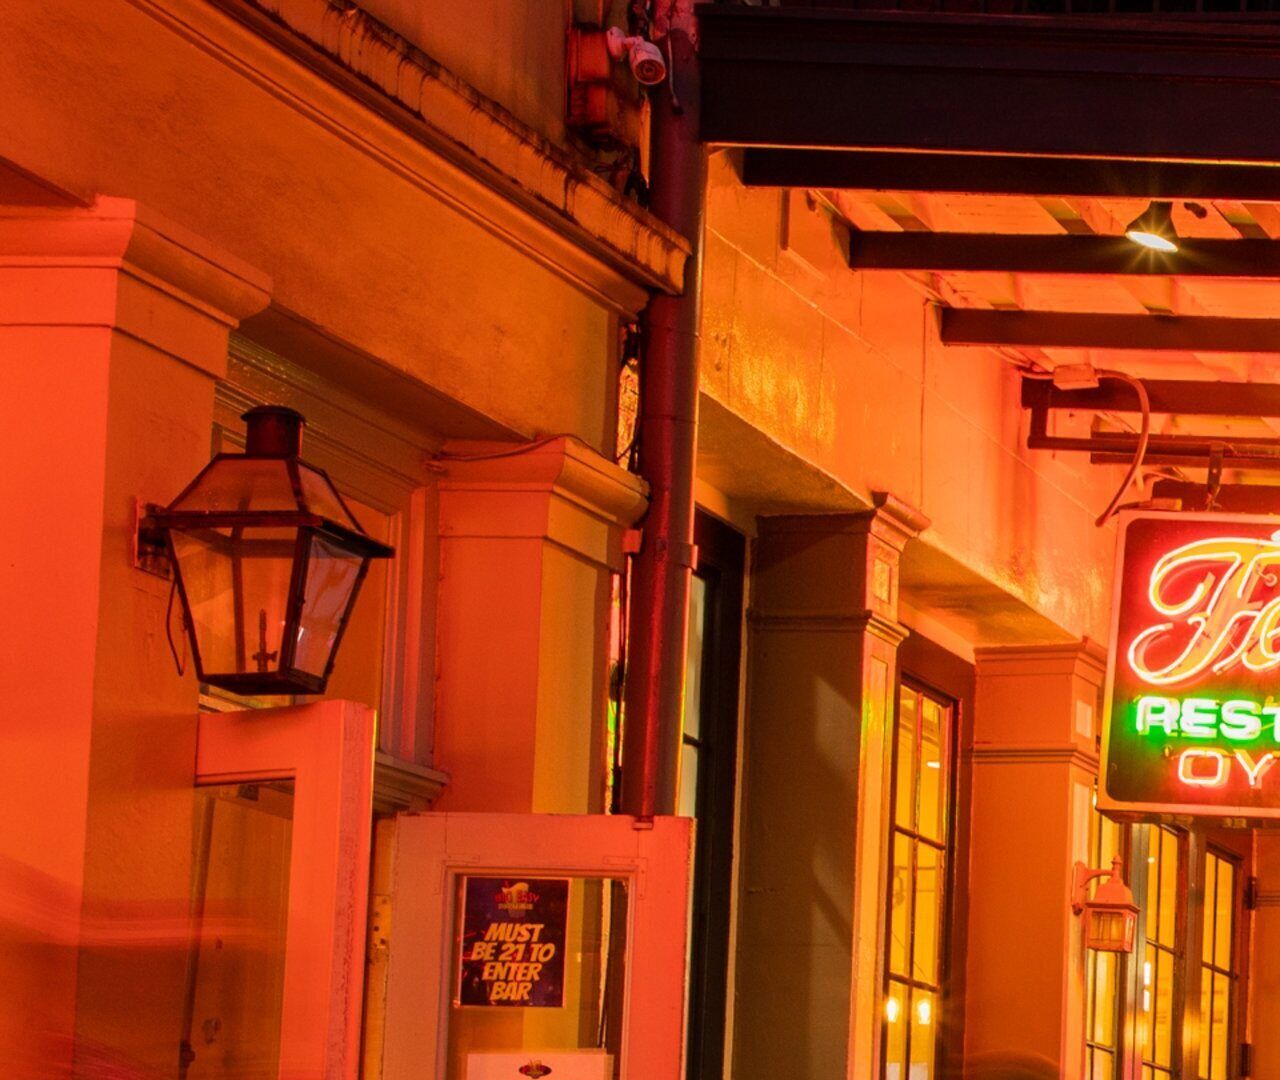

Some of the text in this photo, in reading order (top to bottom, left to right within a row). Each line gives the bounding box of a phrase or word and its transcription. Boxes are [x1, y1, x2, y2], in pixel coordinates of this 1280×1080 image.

[484, 923, 544, 942] MUST
[471, 942, 555, 962] BE 21 TO
[482, 962, 542, 981] ENTER
[490, 982, 532, 1001] BAR
